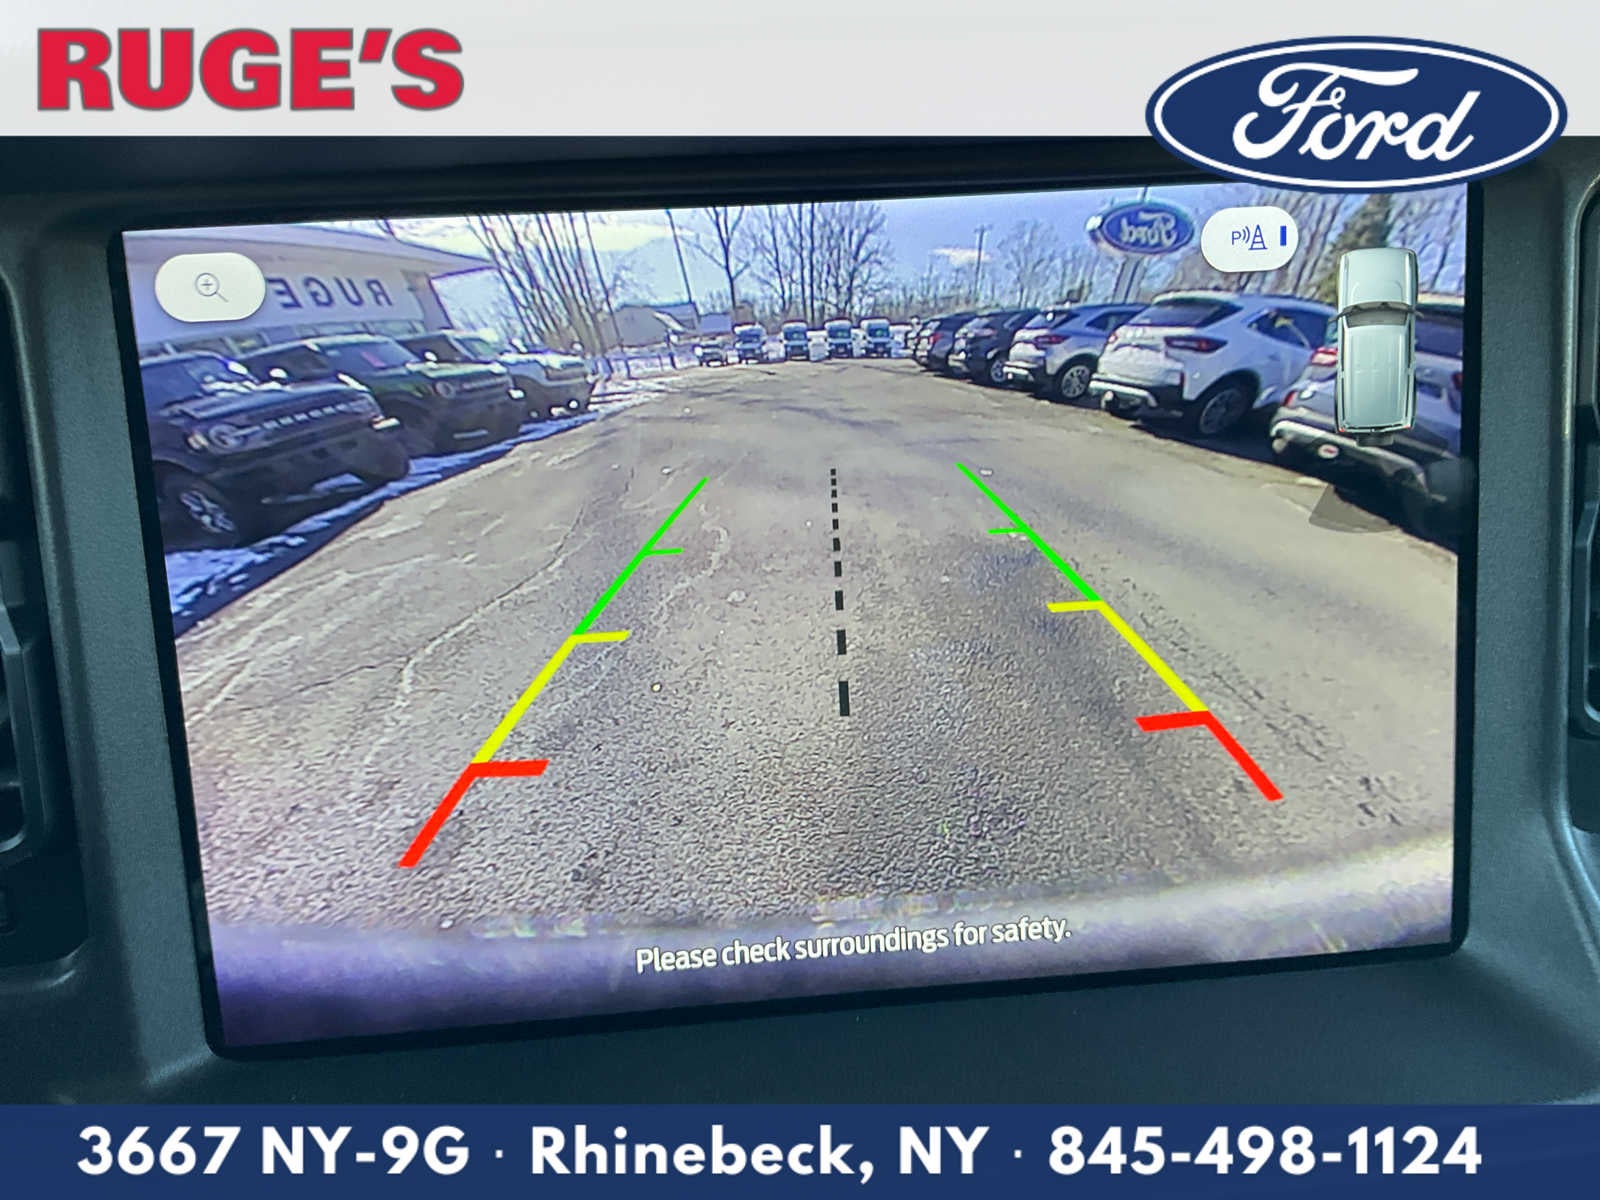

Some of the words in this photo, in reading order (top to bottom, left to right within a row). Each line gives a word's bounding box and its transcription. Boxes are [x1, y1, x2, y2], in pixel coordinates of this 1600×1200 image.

[635, 946, 718, 974] Please
[721, 936, 791, 966] check
[794, 926, 949, 960] surroundings
[953, 920, 988, 946] for
[991, 915, 1072, 943] safety.
